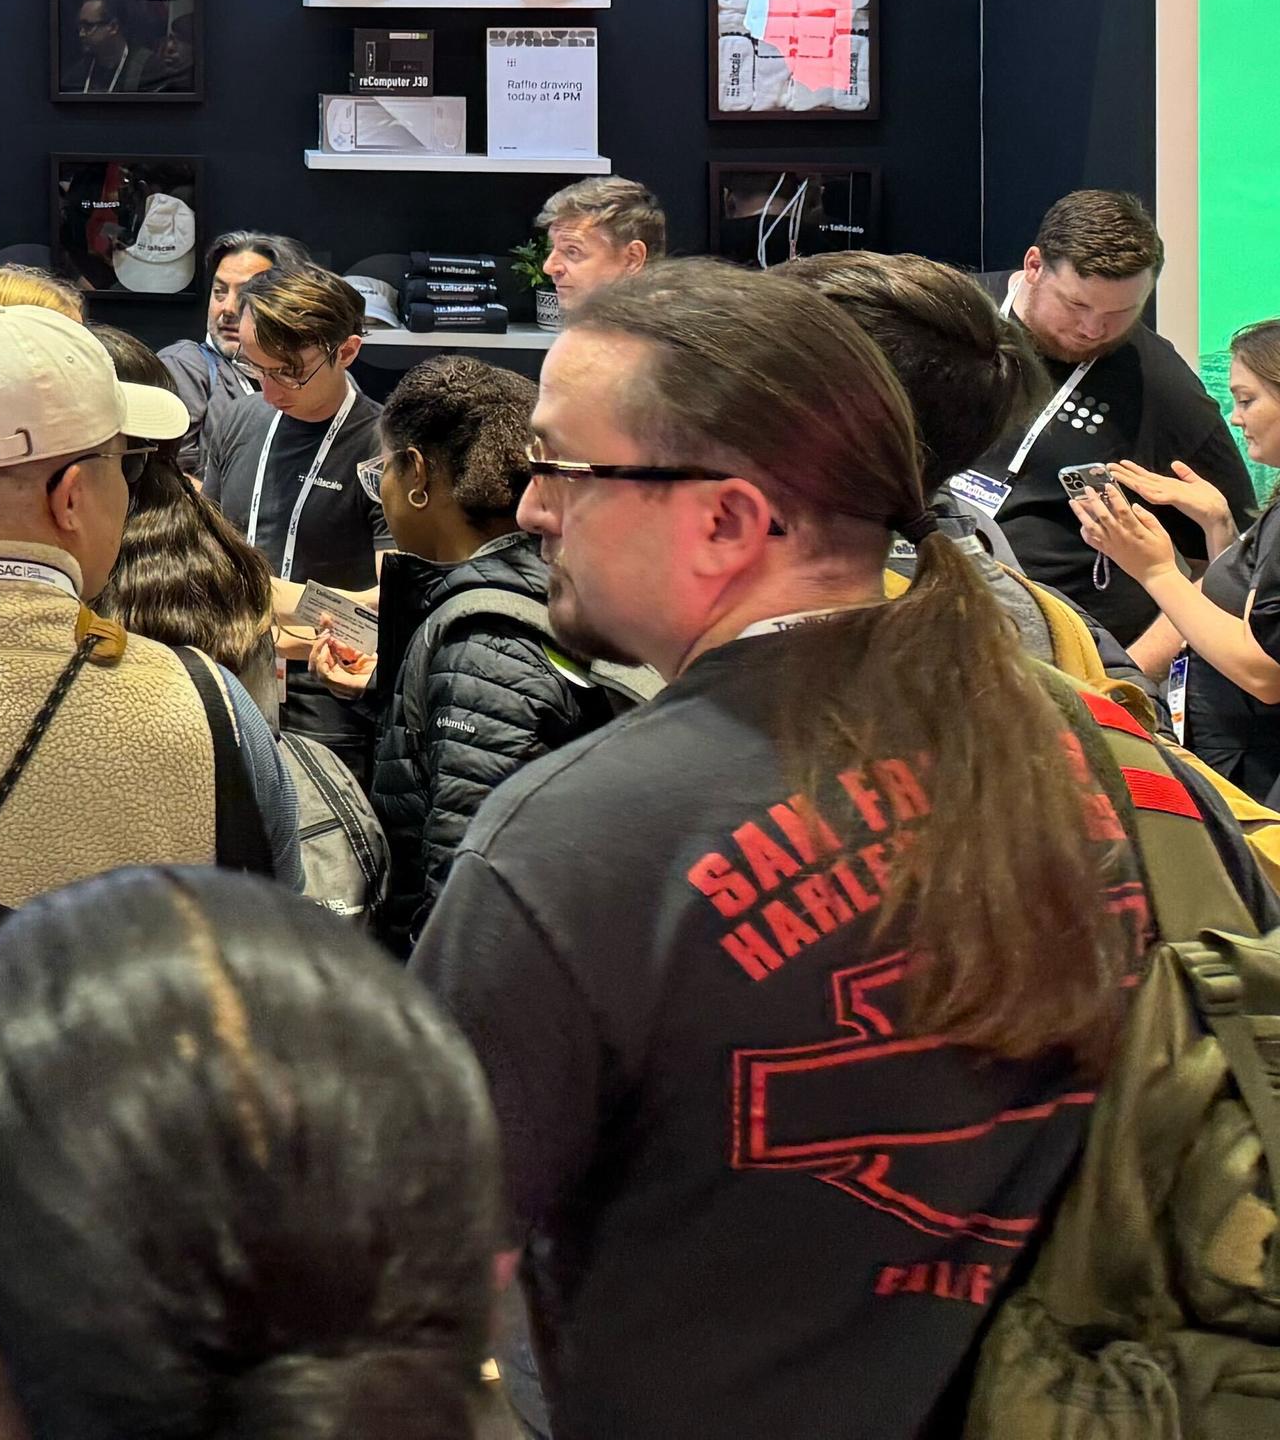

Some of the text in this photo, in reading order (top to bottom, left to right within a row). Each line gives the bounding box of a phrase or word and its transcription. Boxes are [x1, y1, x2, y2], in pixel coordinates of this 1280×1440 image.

[359, 75, 410, 89] reComputer
[507, 79, 582, 93] Raffle drawing
[508, 91, 581, 103] today at 4 PM
[687, 793, 843, 918] SAN
[719, 840, 896, 982] HARLE
